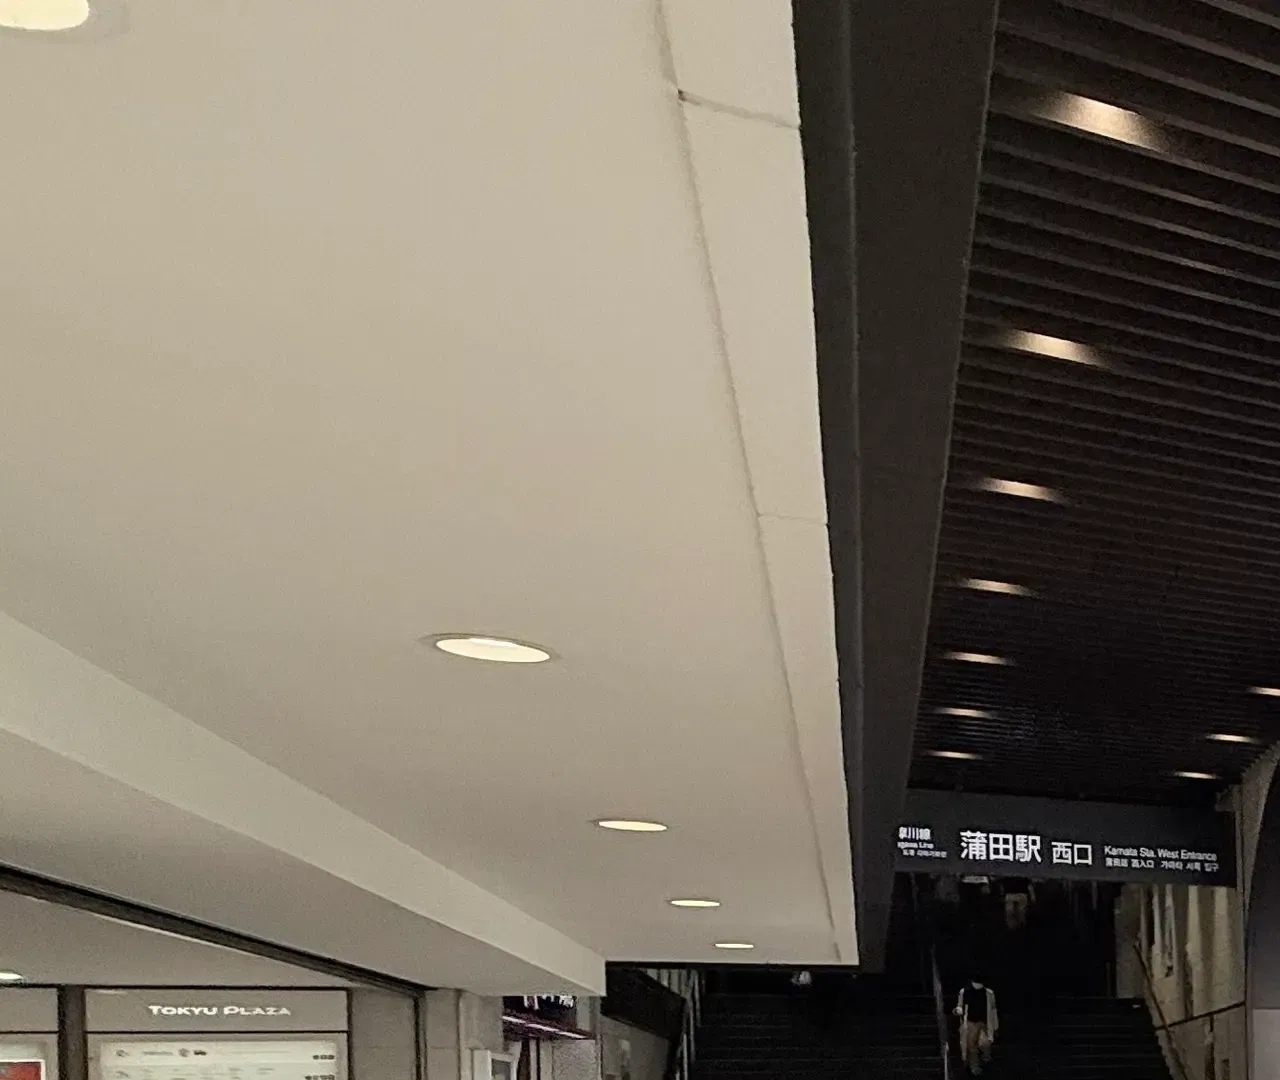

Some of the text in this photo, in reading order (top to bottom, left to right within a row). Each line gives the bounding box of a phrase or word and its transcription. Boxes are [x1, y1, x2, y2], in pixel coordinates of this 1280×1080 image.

[959, 829, 1042, 863] 蒲田駅
[1051, 841, 1093, 865] 西口
[1104, 845, 1138, 856] Kamata
[1157, 848, 1179, 859] West
[1180, 849, 1218, 861] Entrance
[148, 1005, 291, 1016] TOKYU PLAZA
